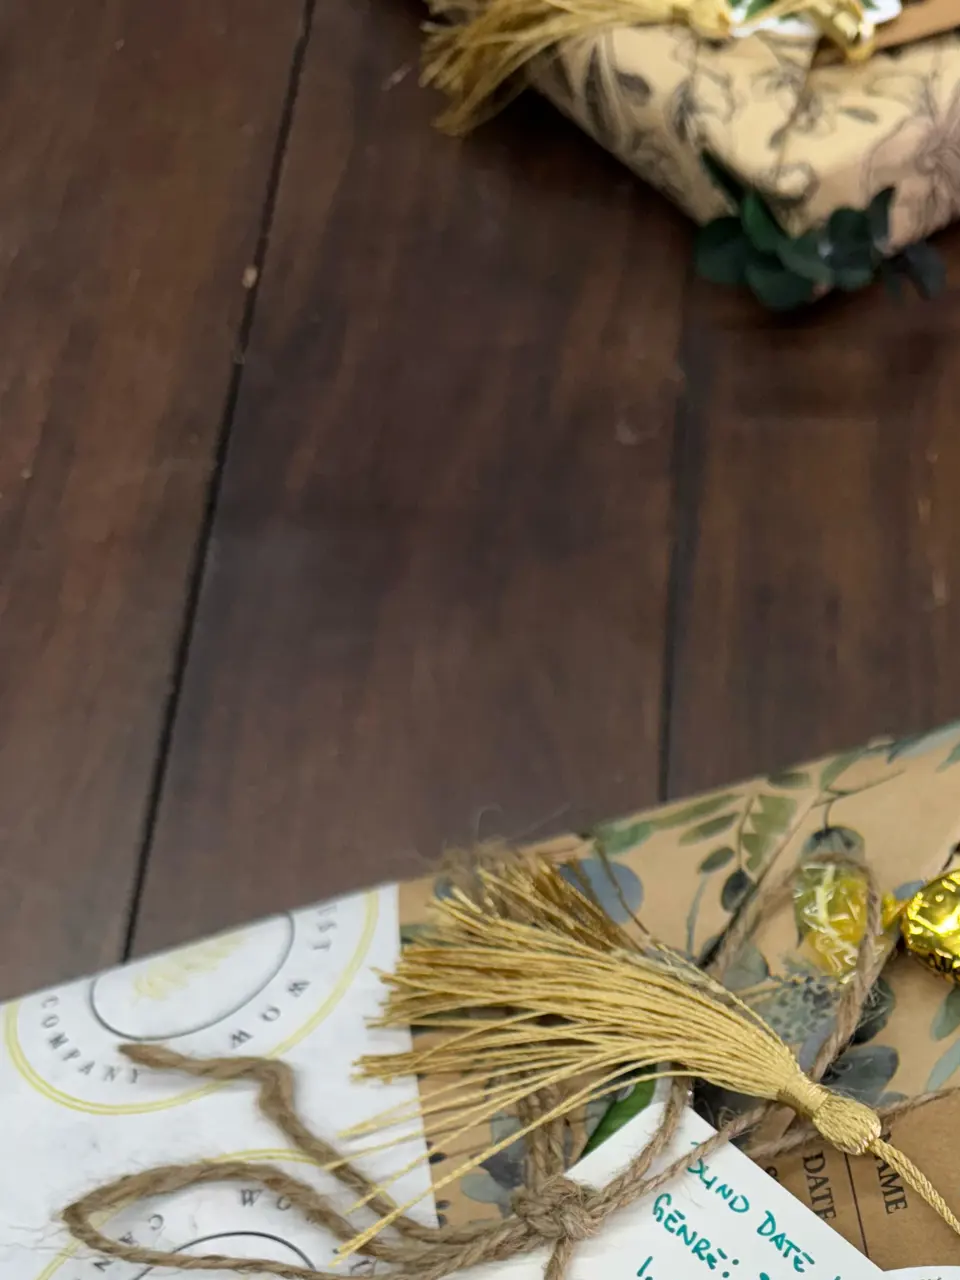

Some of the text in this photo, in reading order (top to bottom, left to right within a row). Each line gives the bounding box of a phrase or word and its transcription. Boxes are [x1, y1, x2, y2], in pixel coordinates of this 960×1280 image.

[40, 994, 143, 1084] COMPANY
[228, 977, 311, 1049] WOW
[802, 1149, 837, 1221] DATE
[652, 1193, 741, 1279] GENRE:
[756, 1210, 817, 1275] DATE
